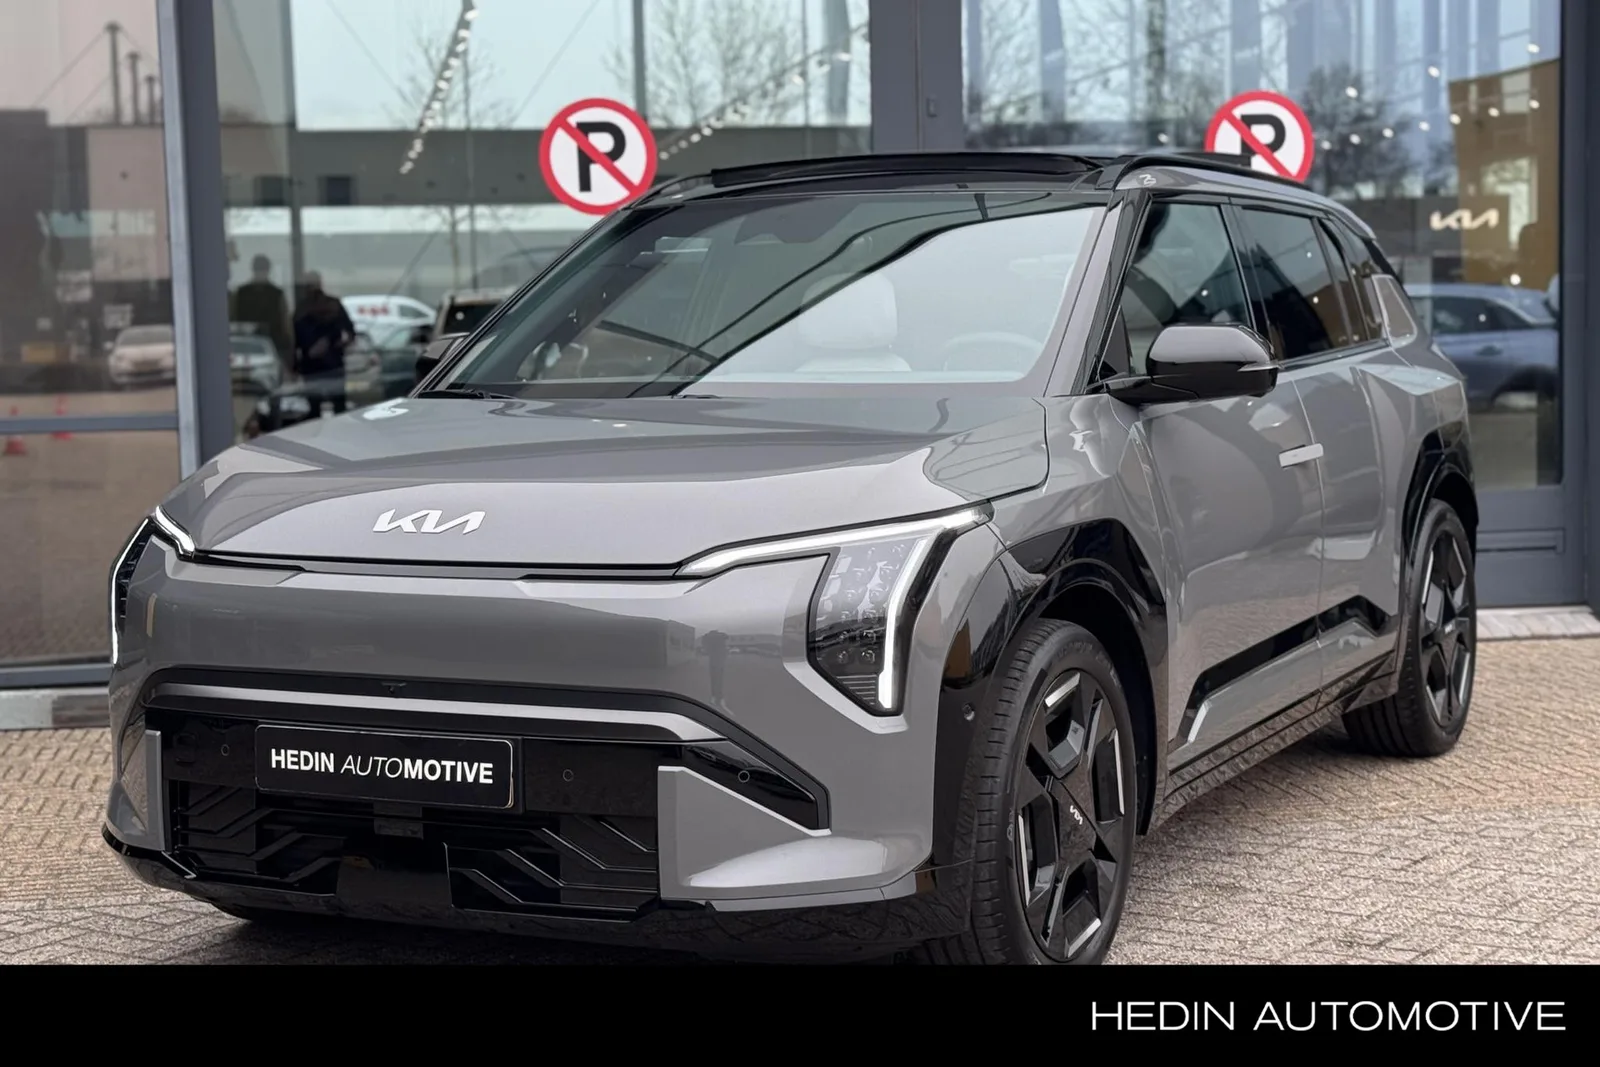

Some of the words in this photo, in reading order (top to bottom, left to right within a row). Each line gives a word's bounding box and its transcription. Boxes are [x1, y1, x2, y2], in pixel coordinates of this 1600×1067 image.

[576, 122, 626, 192] P
[372, 508, 486, 535] KIA
[271, 748, 335, 773] HEDIN
[340, 754, 494, 784] AUTOMOTIVE
